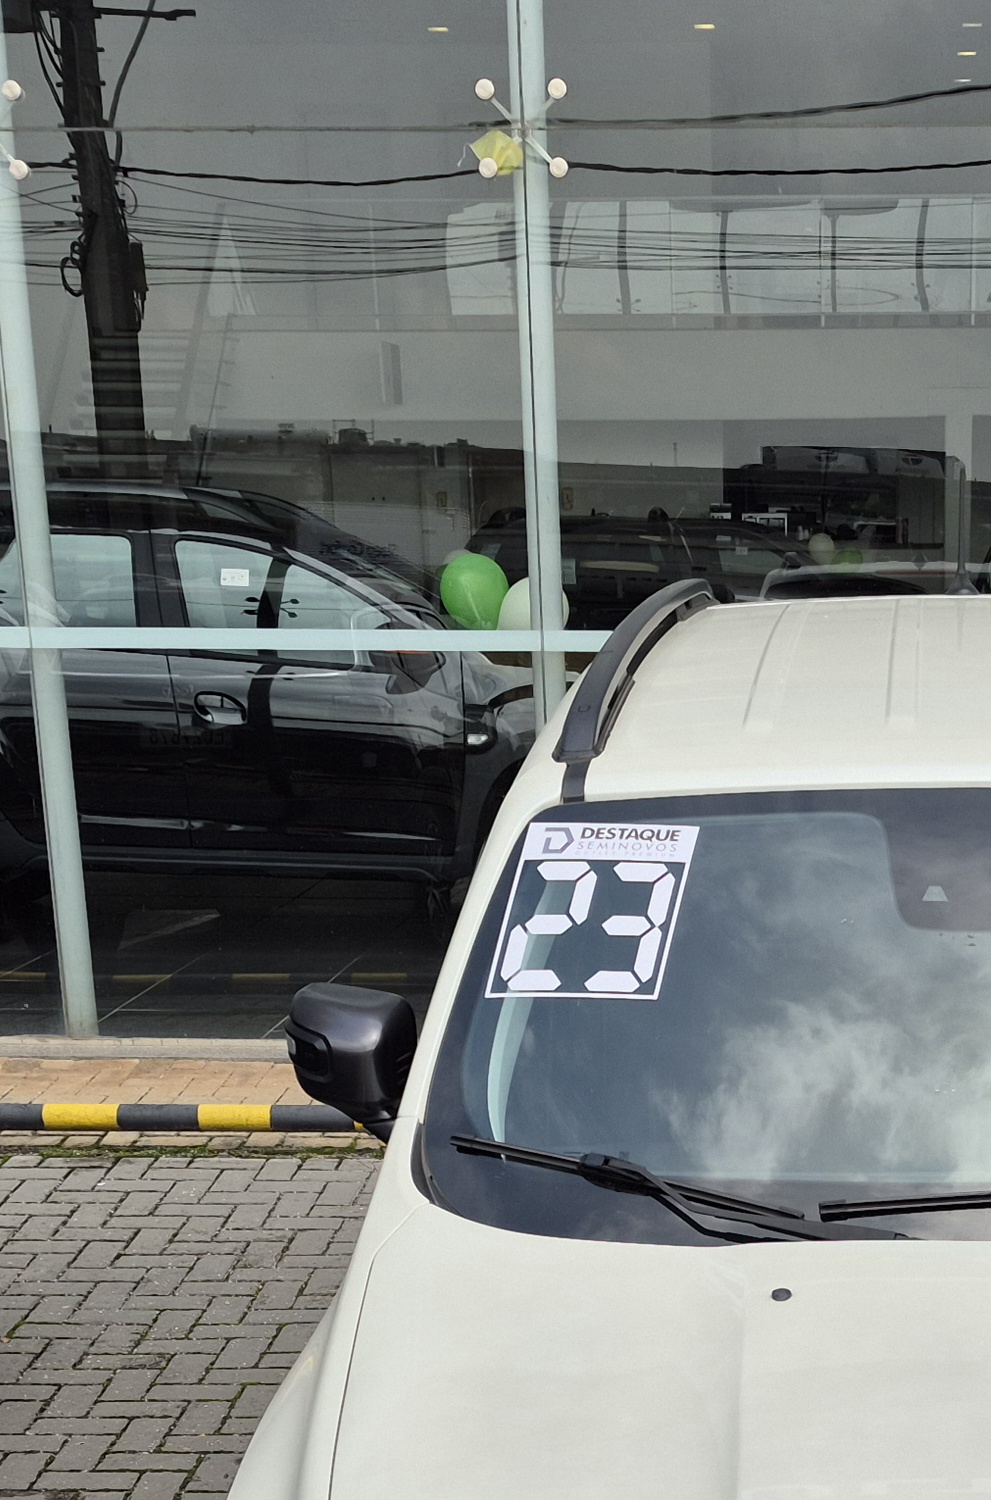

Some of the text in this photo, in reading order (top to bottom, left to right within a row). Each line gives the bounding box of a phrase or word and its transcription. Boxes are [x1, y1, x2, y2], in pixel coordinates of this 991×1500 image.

[580, 827, 682, 842] DESTAQUE
[577, 841, 677, 852] SEMINOVOS
[500, 861, 675, 992] 23
